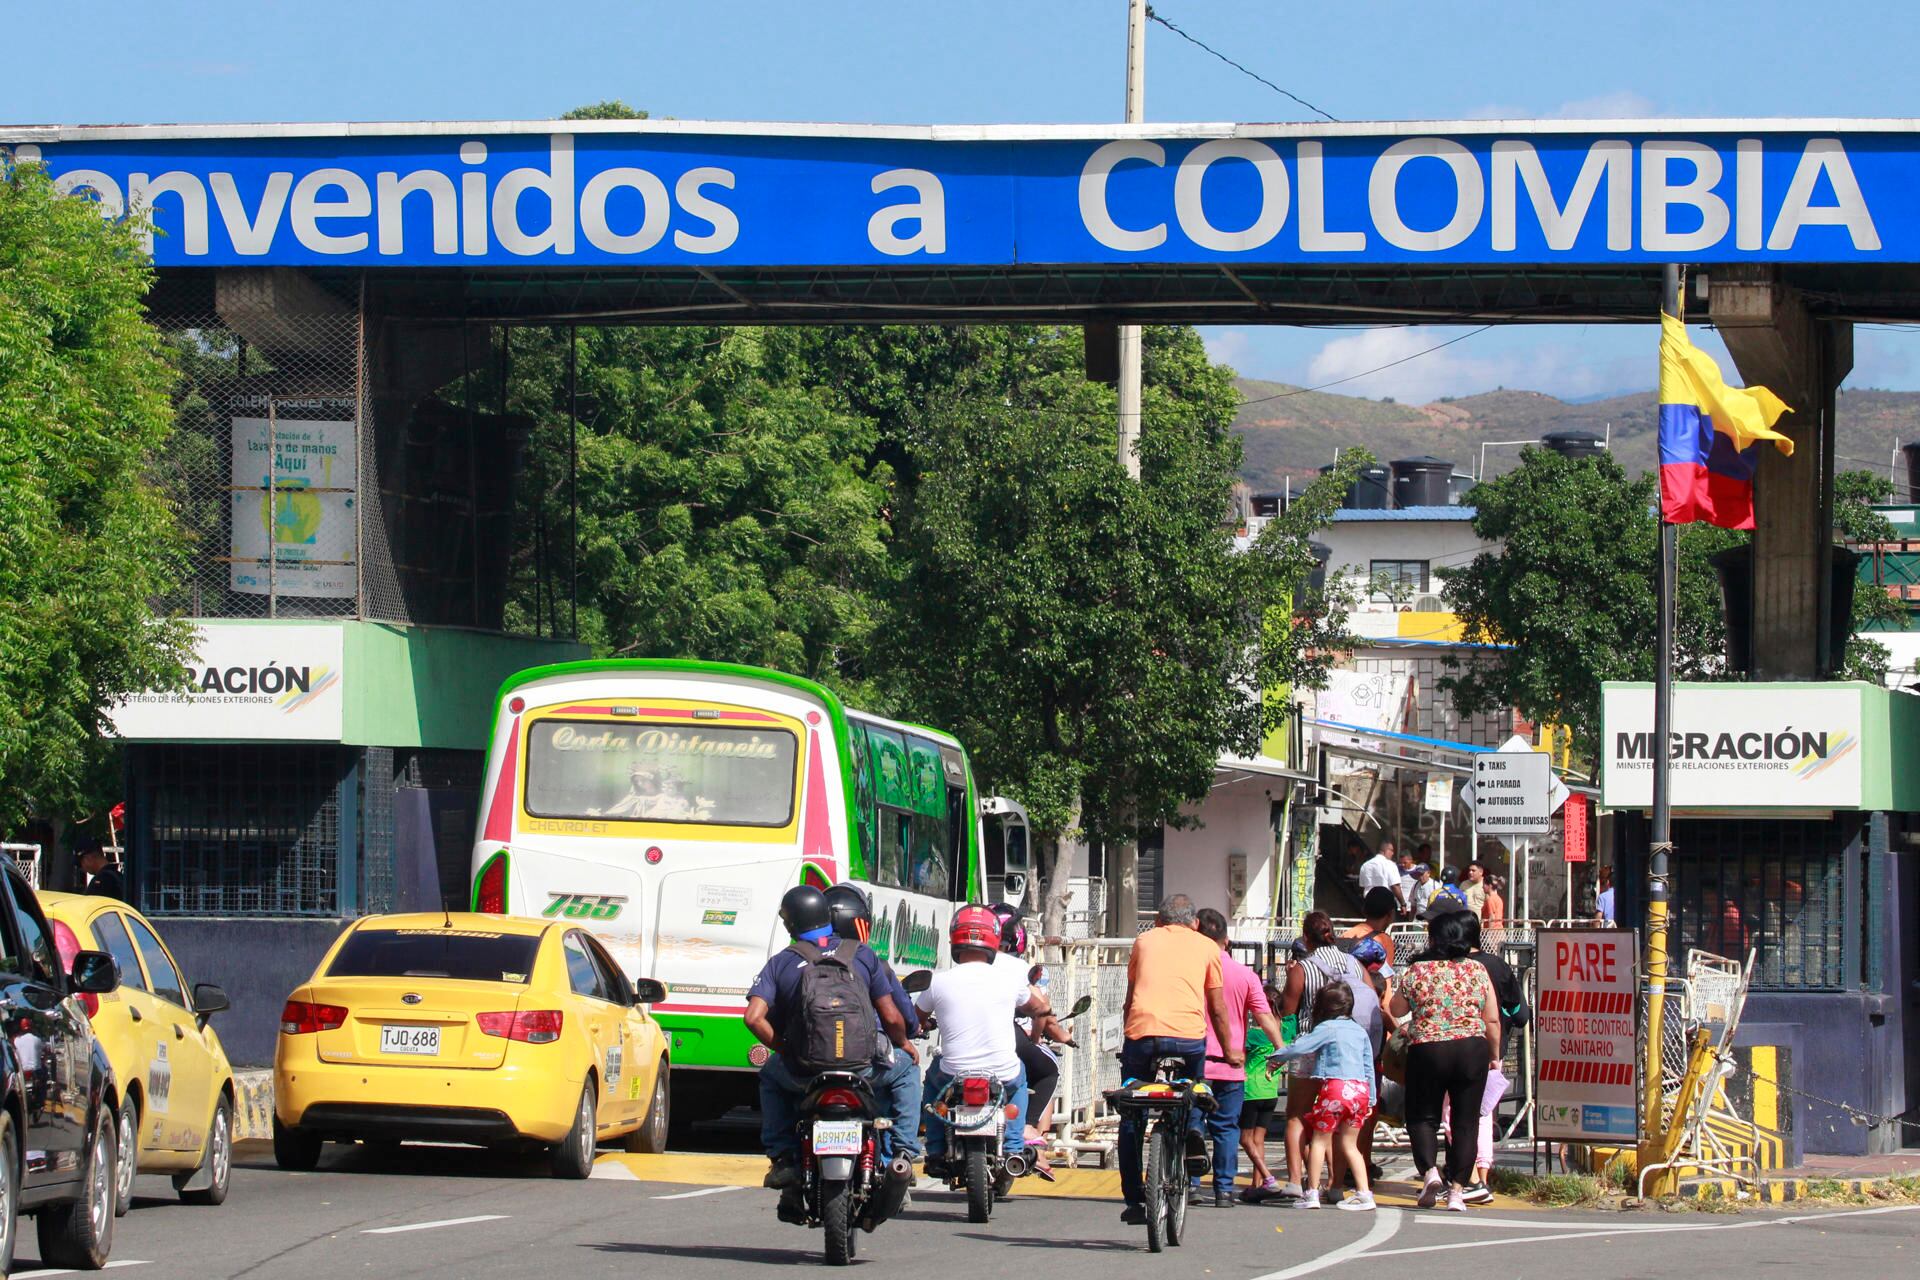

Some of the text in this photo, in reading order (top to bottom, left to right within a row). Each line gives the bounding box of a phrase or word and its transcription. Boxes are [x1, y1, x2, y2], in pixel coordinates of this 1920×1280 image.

[867, 168, 946, 256] a
[1078, 137, 1882, 252] COLOMBIA
[248, 439, 282, 452] Lavao
[302, 444, 337, 455] manos
[223, 695, 273, 704] EXTERIORES
[636, 729, 777, 759] Distancia
[1488, 761, 1507, 770] TAXIS
[1682, 761, 1736, 770] RELACIONES
[1737, 761, 1789, 770] EXTERIORES
[1487, 779, 1521, 789] LA PARADA
[1487, 796, 1525, 806] AUTOBUSES
[1487, 816, 1549, 825] CAMBIO DE DIVISAS
[541, 890, 630, 922] 755
[1556, 941, 1617, 983] PARE
[1538, 1016, 1634, 1037] PUESTO DE CONTROL
[1560, 1038, 1614, 1057] SANITARIO
[1538, 1104, 1556, 1121] ICA
